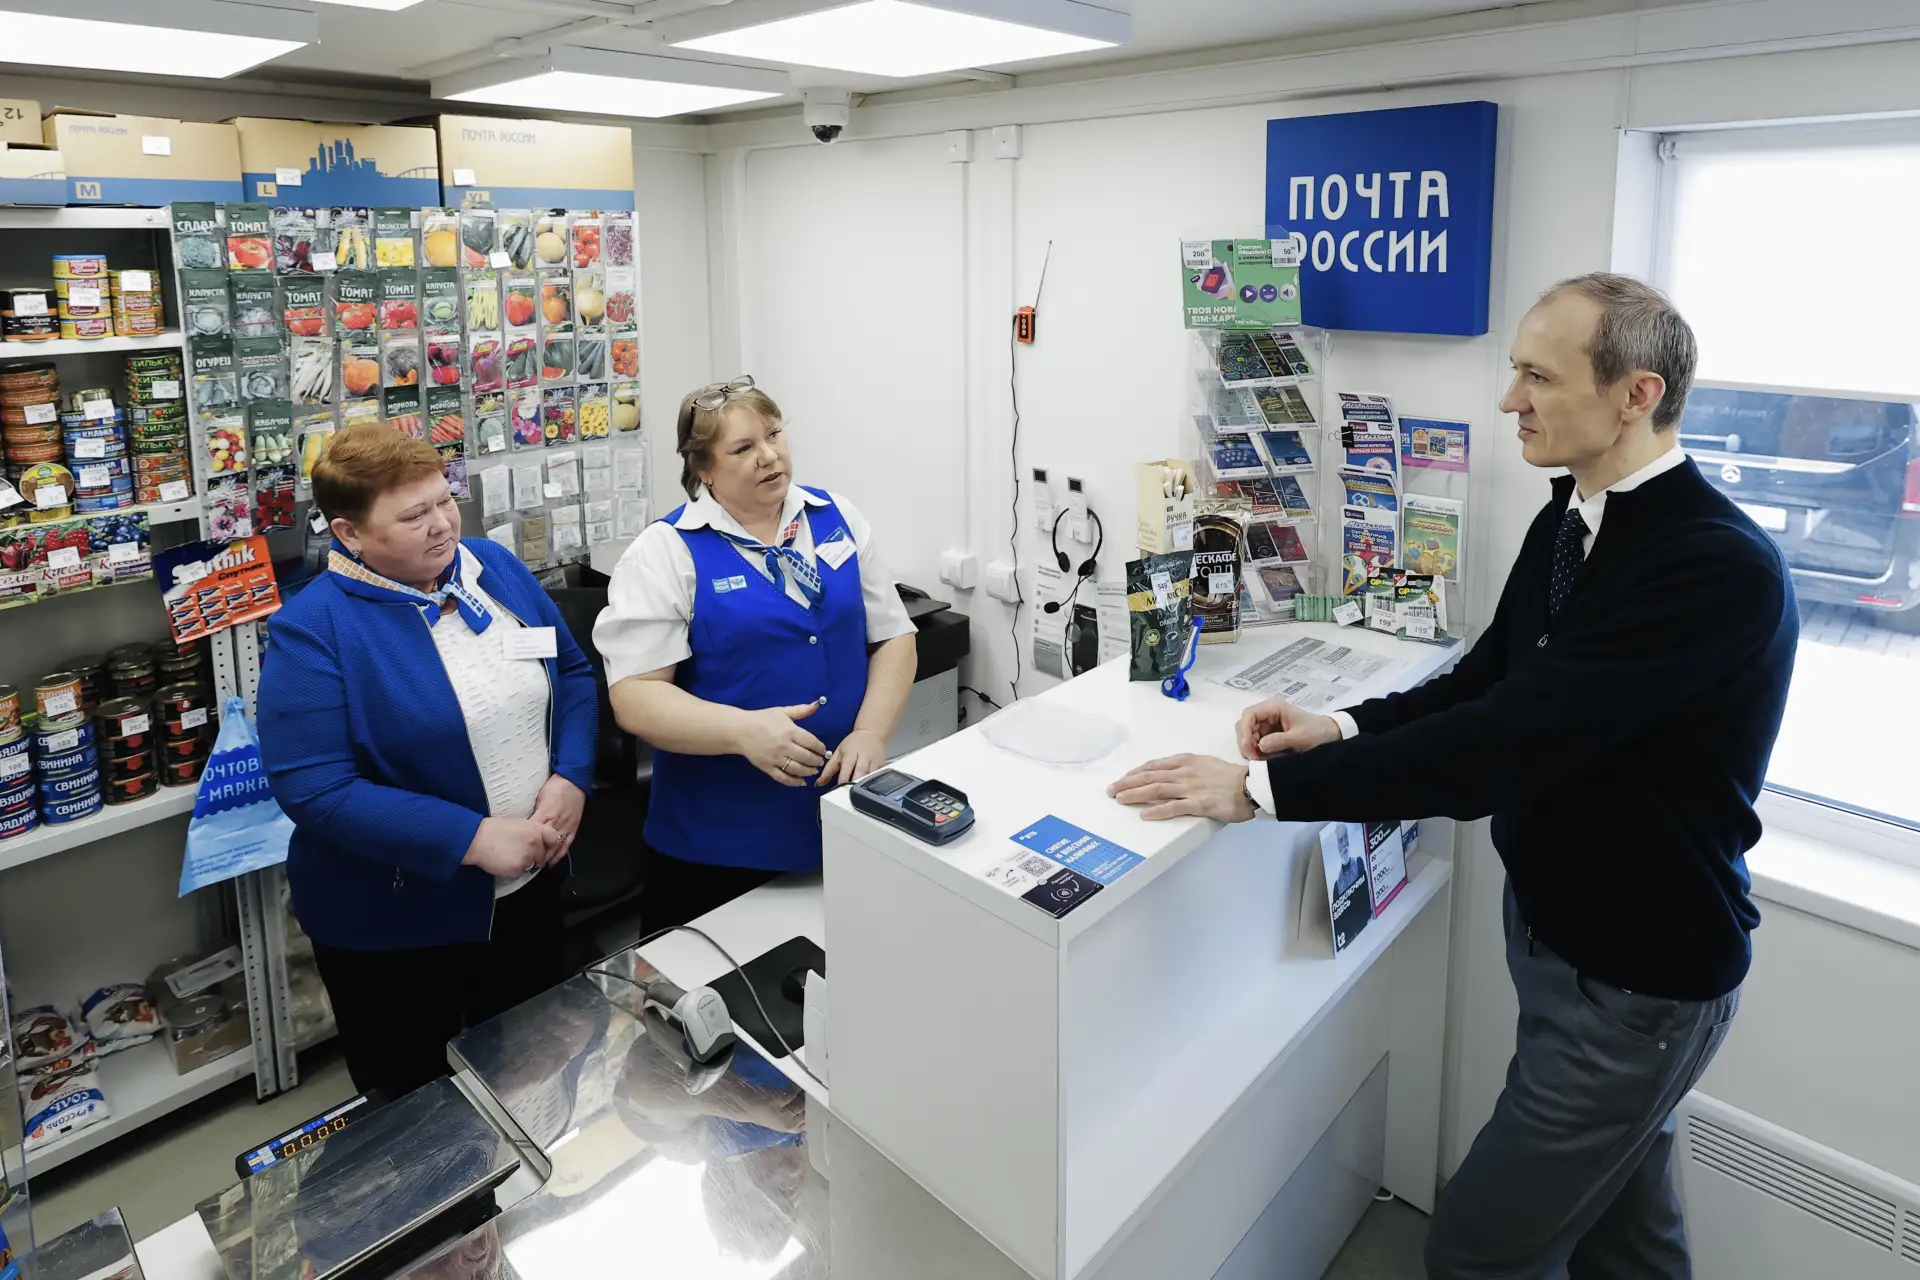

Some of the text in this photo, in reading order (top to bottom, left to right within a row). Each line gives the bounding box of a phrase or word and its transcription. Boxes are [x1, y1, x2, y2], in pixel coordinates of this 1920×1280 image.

[462, 128, 536, 144] ПОЧТА РОССИИ
[80, 184, 97, 196] M
[263, 184, 273, 195] L
[1288, 170, 1450, 220] ПОЧТА
[176, 220, 215, 232] САЛАТ
[230, 221, 268, 232] ТОМАТ
[384, 284, 415, 295] ТОМАТ
[425, 281, 455, 290] КАПУСТА
[189, 288, 226, 297] КАПУСТА
[235, 291, 273, 301] КАПУСТА
[287, 292, 322, 303] ТОМАТ
[340, 287, 374, 298] ТОМАТ
[195, 356, 232, 368] ОГУРЕЦ
[387, 400, 419, 410] МОРКОВЬ
[429, 400, 460, 411] МОРКОВЬ
[254, 417, 291, 427] КАБАЧОК
[82, 428, 115, 438] КИЛЬКА
[105, 442, 126, 452] ИЛЬКА
[1166, 512, 1187, 523] РУЧКА
[171, 544, 256, 585] Sutnik
[1195, 553, 1238, 565] ЕСКАФЕ
[217, 562, 265, 580] Спутник
[1370, 578, 1382, 586] GP
[204, 758, 263, 782] ОЧТОВ
[54, 769, 99, 792] СВИНИНА
[209, 776, 270, 802] МАРКА
[55, 793, 101, 815] СВИНИНА
[1044, 837, 1072, 855] СНЯТИЕ
[1060, 834, 1093, 857] ВНЕСЕНИЕ
[1065, 840, 1101, 864] НАЛИЧНЫХ
[1332, 875, 1366, 912] ПОДКЛЮЧИМ
[1332, 900, 1351, 920] ЗДЕСЬ
[50, 1090, 90, 1113] СОЛЬ
